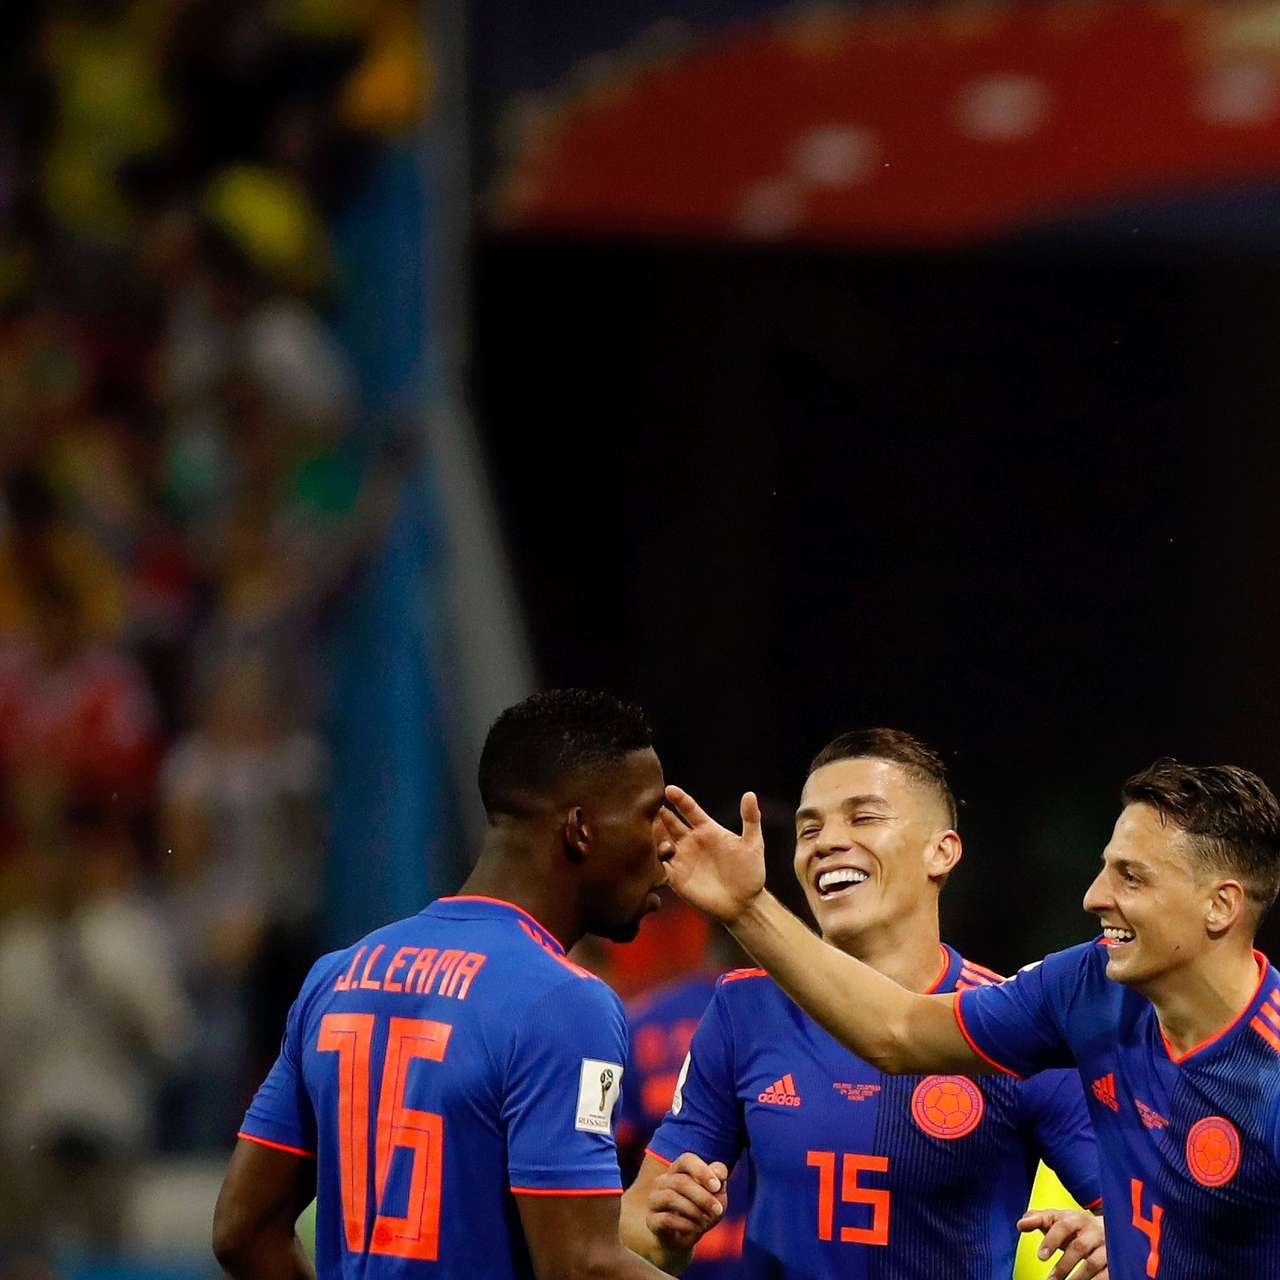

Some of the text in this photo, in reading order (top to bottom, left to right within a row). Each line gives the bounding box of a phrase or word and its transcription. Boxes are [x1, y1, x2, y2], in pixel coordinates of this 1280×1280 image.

[333, 944, 487, 1000] J.LERMA
[316, 1014, 453, 1262] 16
[758, 1092, 801, 1107] adidas
[806, 1150, 891, 1246] 15
[1131, 1178, 1164, 1279] 4
